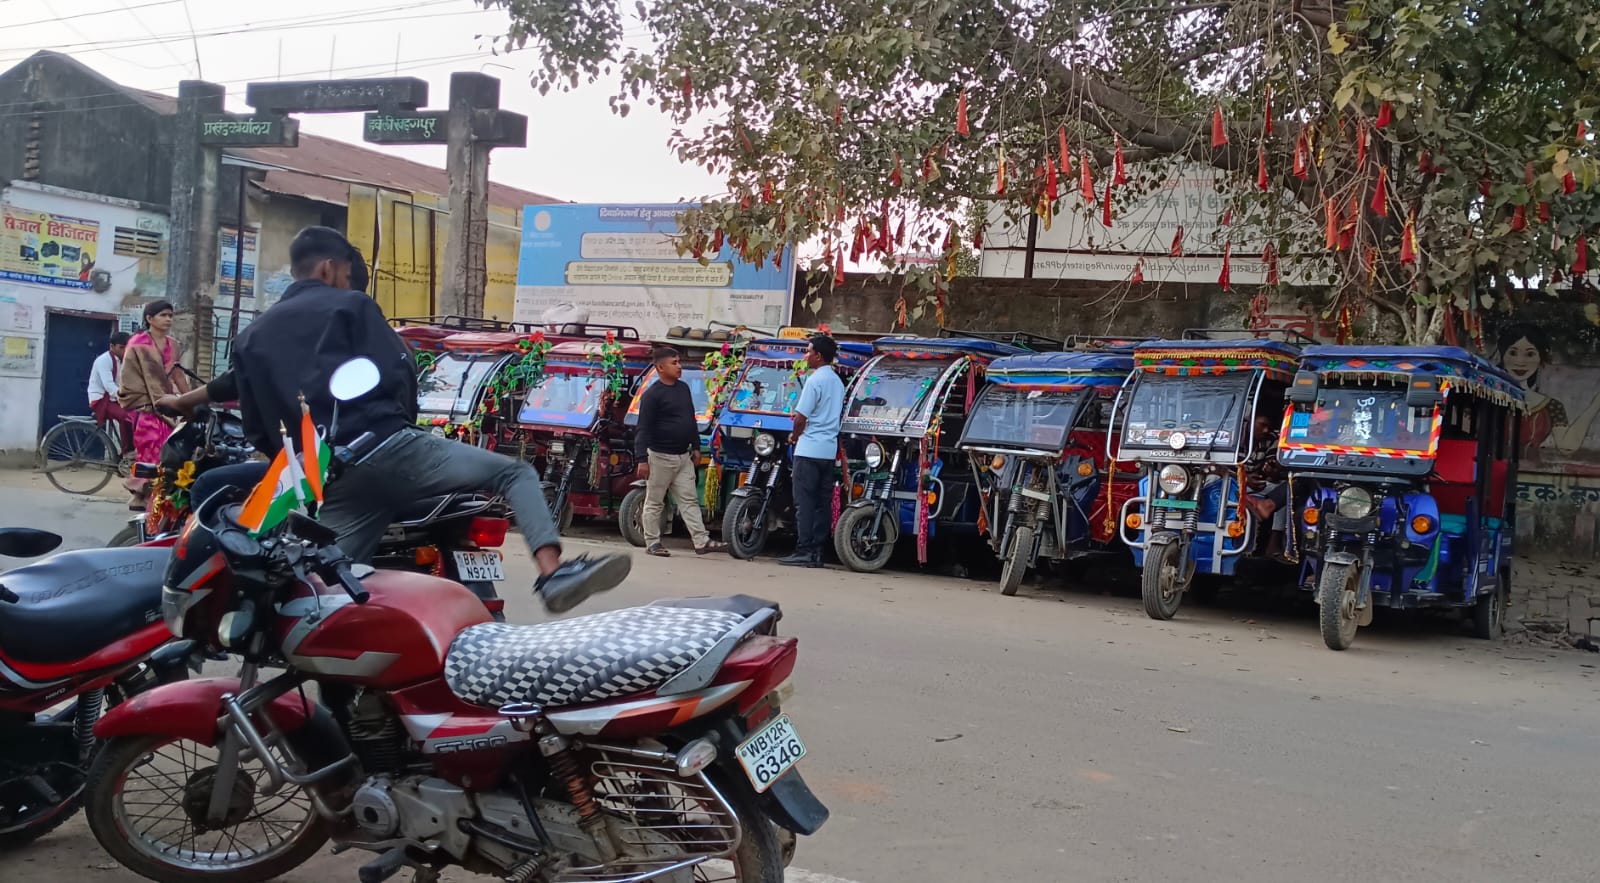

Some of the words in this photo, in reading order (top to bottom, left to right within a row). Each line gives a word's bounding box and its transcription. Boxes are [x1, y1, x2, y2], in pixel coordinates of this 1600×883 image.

[4, 213, 42, 234] सेजल
[47, 220, 97, 242] डिजिटल
[463, 553, 477, 566] BR
[481, 553, 496, 566] 08
[466, 566, 500, 580] N9214
[746, 721, 787, 758] WB12R
[755, 739, 801, 783] 6346
